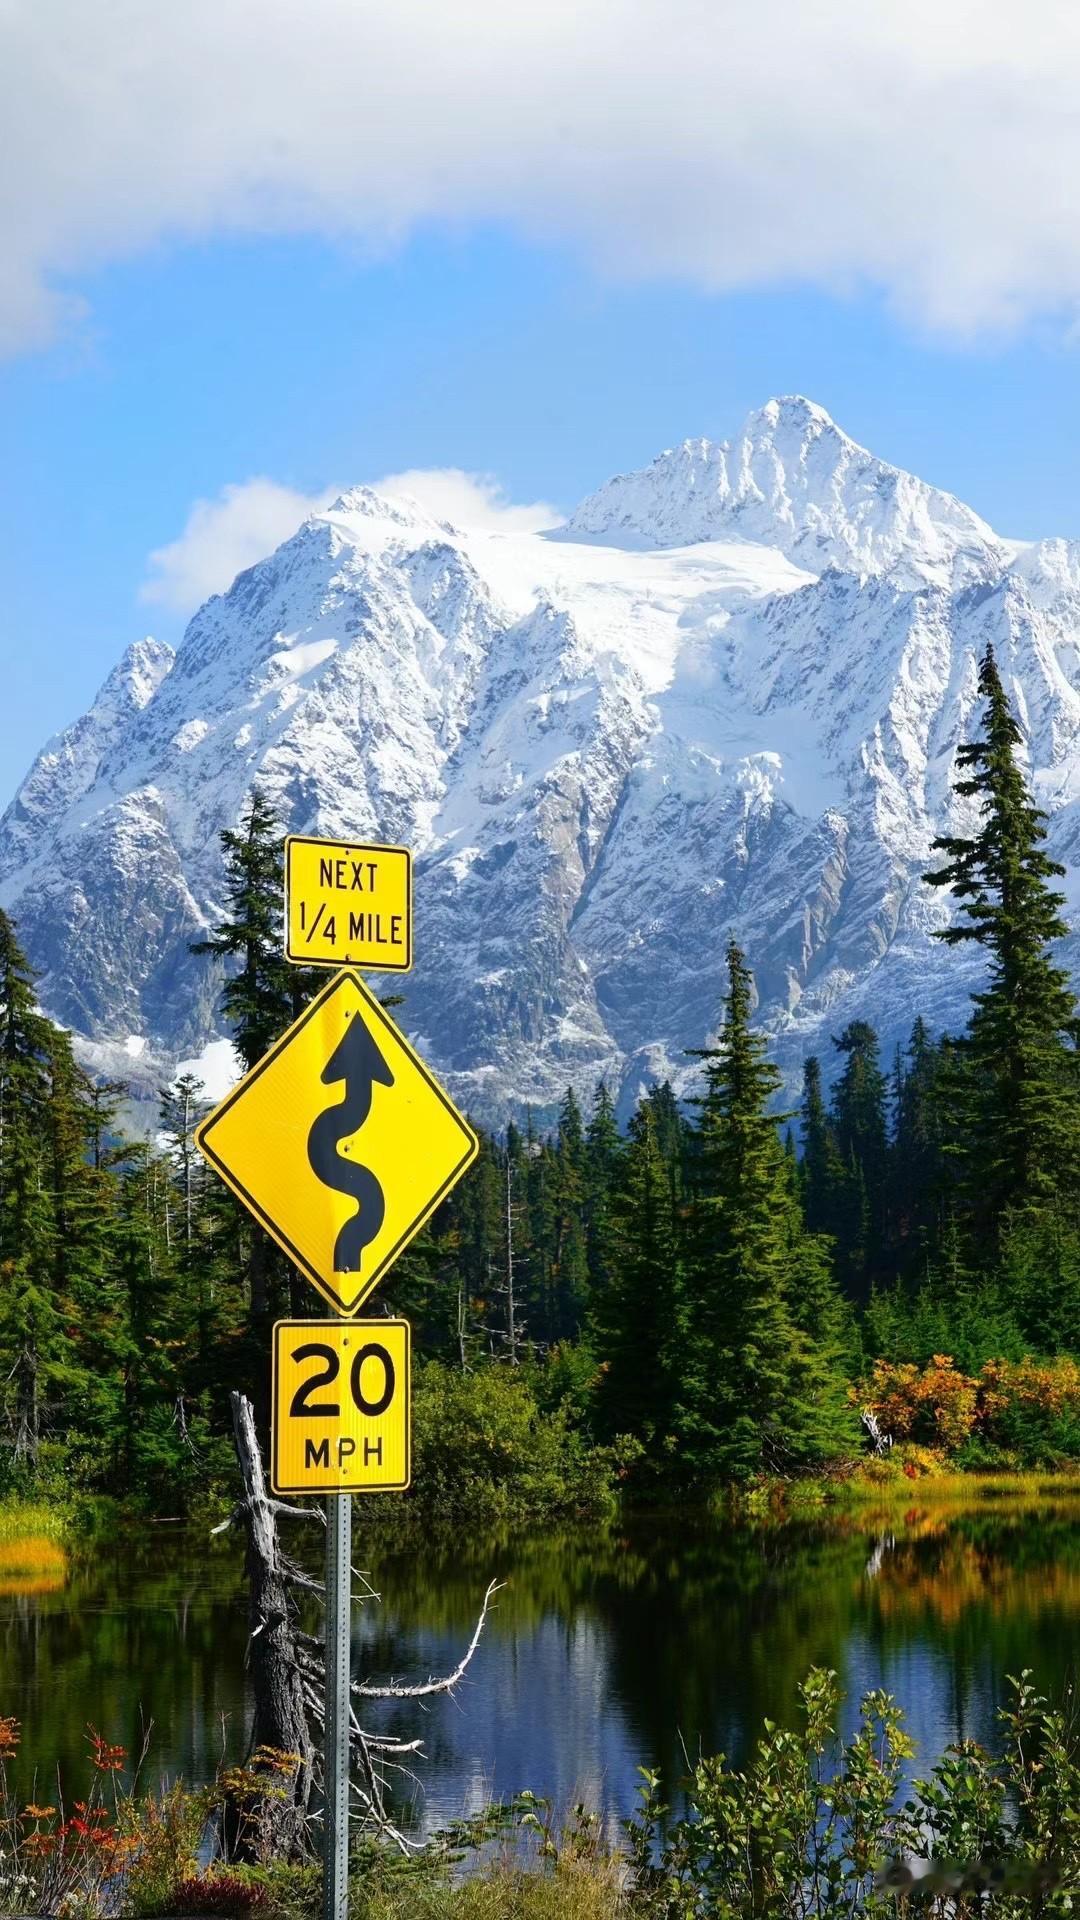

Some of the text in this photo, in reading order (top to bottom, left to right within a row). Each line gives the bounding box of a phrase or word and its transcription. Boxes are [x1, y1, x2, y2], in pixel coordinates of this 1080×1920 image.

[320, 858, 378, 892] NEXT
[300, 901, 403, 945] 1/4 MILE
[289, 1342, 395, 1417] 20
[304, 1436, 382, 1469] MPH
